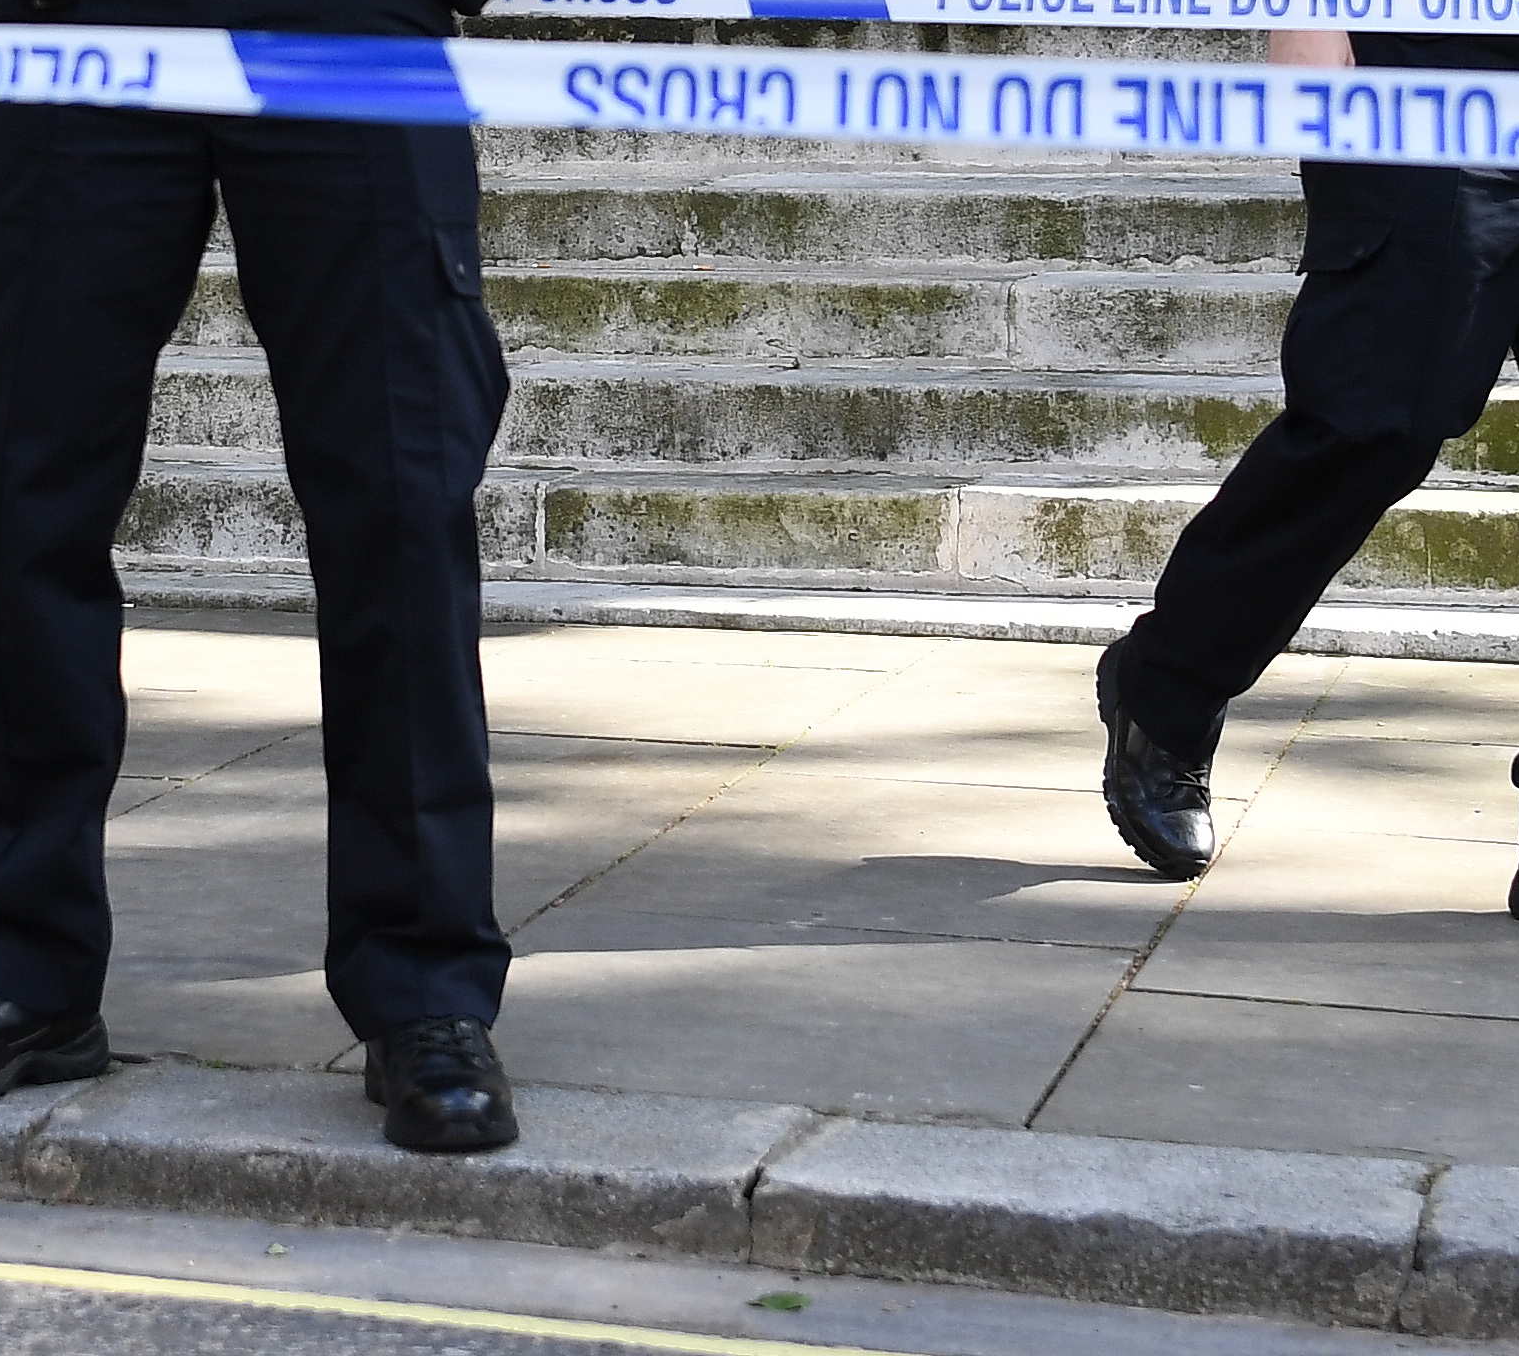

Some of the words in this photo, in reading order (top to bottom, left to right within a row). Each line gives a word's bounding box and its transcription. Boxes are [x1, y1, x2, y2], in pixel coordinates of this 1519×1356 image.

[563, 62, 798, 129] CROSS
[990, 74, 1085, 140] DO
[1113, 77, 1267, 148] LINE
